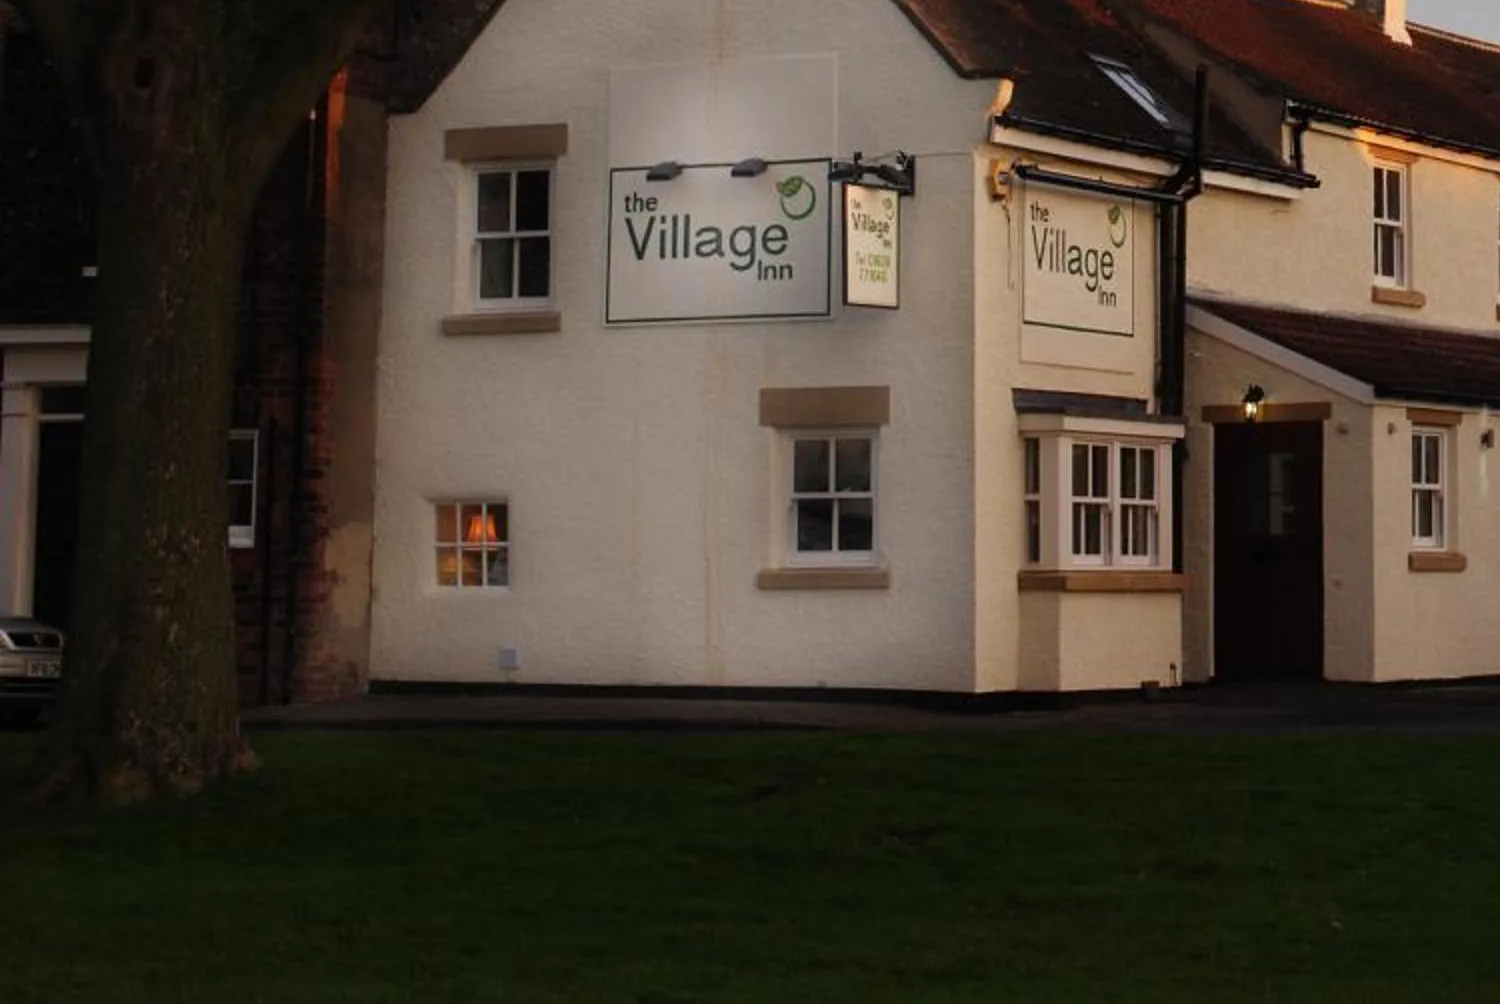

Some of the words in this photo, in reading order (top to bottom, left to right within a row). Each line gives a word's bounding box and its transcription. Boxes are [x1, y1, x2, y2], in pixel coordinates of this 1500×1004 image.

[624, 192, 658, 213] the
[1030, 201, 1049, 223] the
[852, 211, 890, 239] Village
[624, 214, 788, 271] Village
[1031, 225, 1114, 292] Village
[757, 260, 793, 281] Inn
[1098, 286, 1117, 308] Inn
